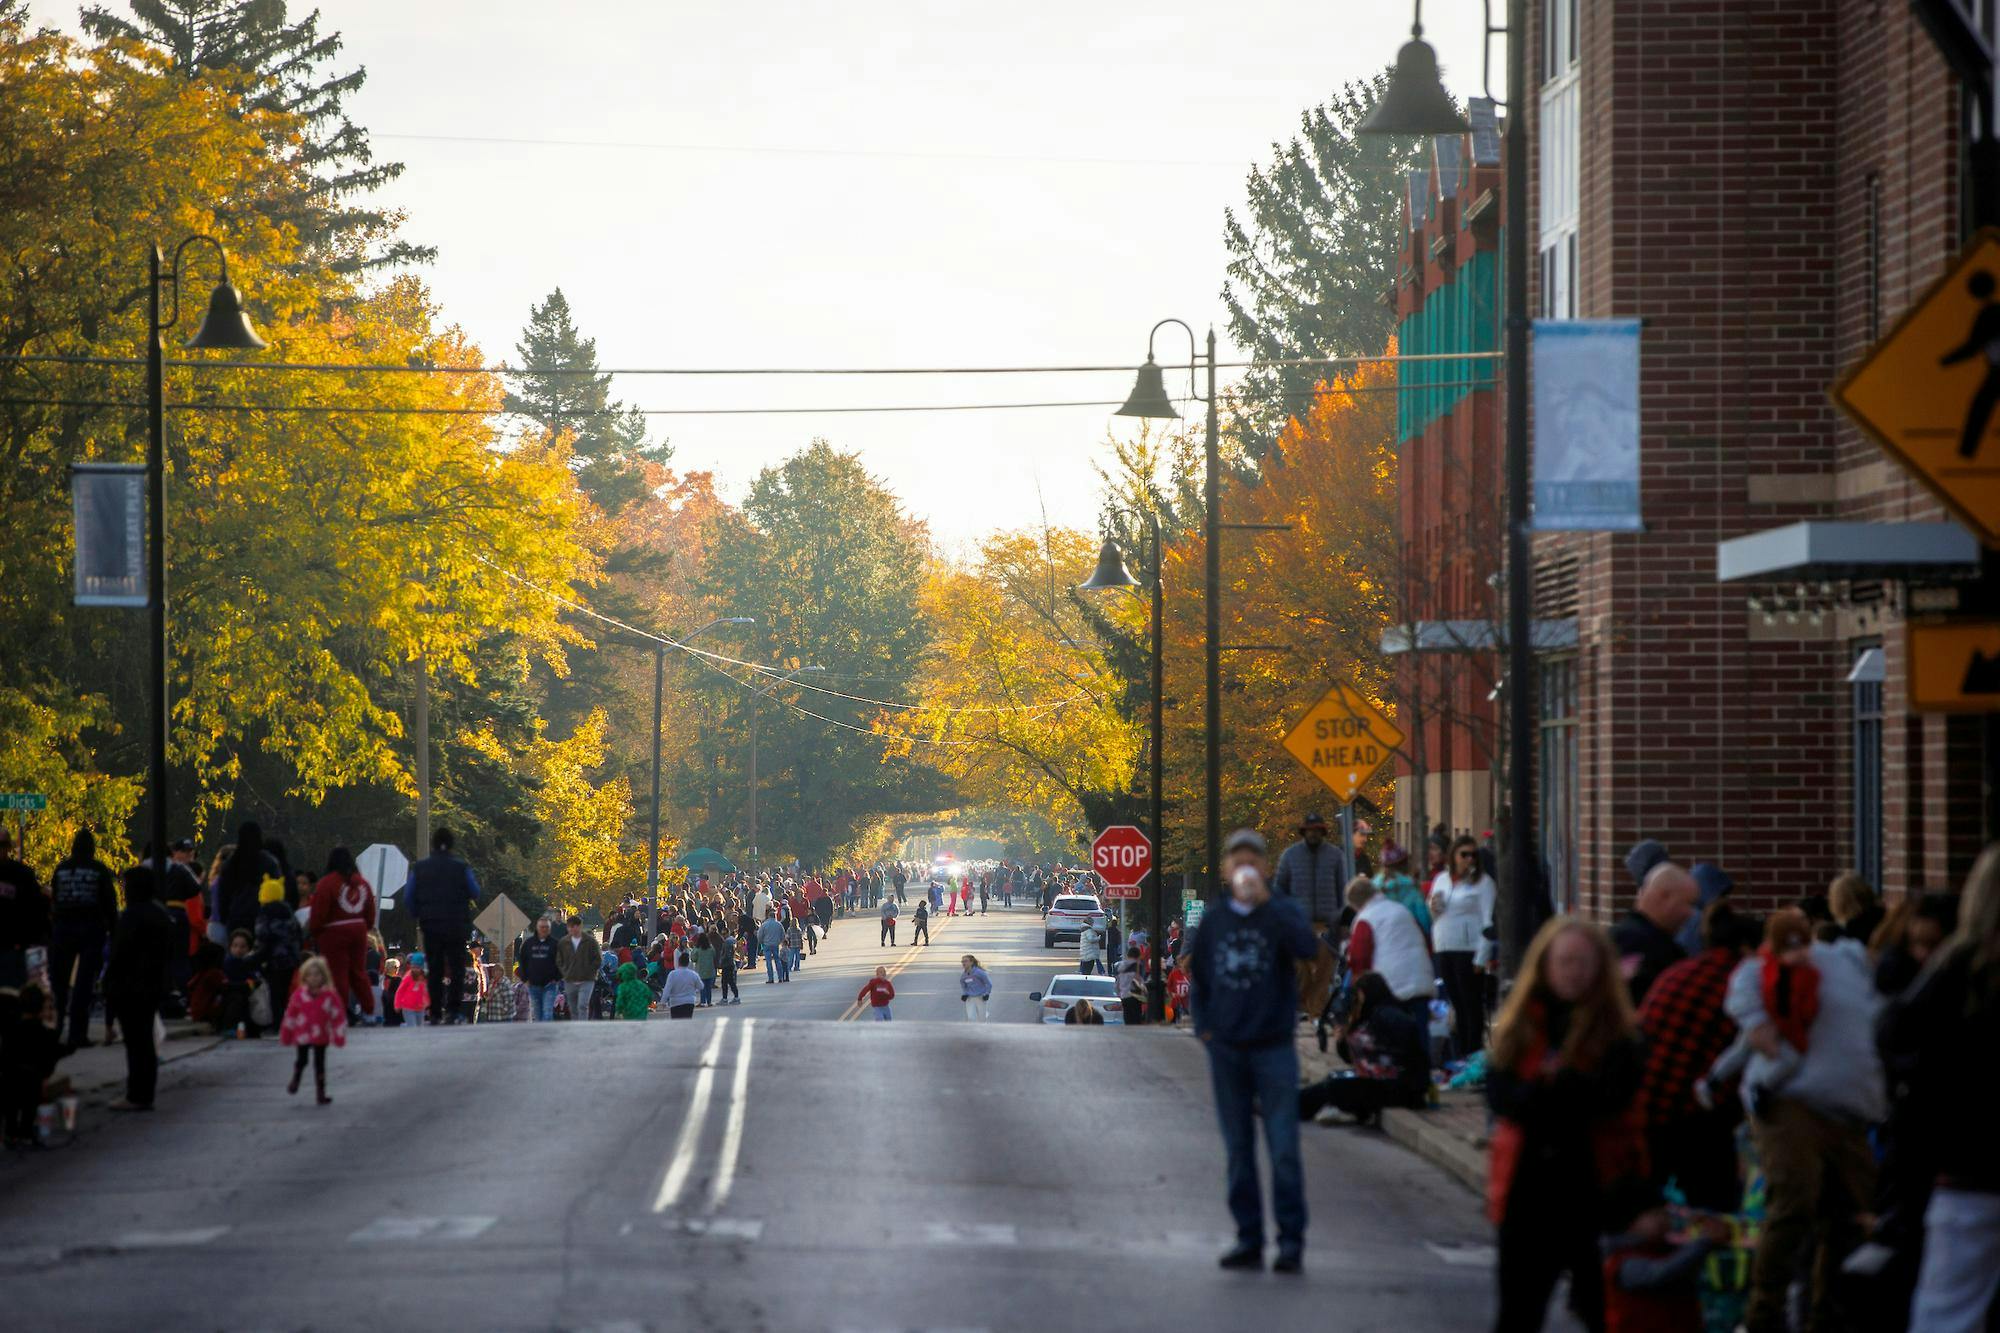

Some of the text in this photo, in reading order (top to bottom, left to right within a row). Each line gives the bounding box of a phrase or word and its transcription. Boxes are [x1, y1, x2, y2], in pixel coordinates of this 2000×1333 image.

[1315, 717, 1370, 739] STOP
[1312, 745, 1377, 768] AHEAD
[9, 794, 35, 809] Dicks
[1097, 845, 1148, 868] STOP
[1108, 889, 1137, 897] ALL WAY
